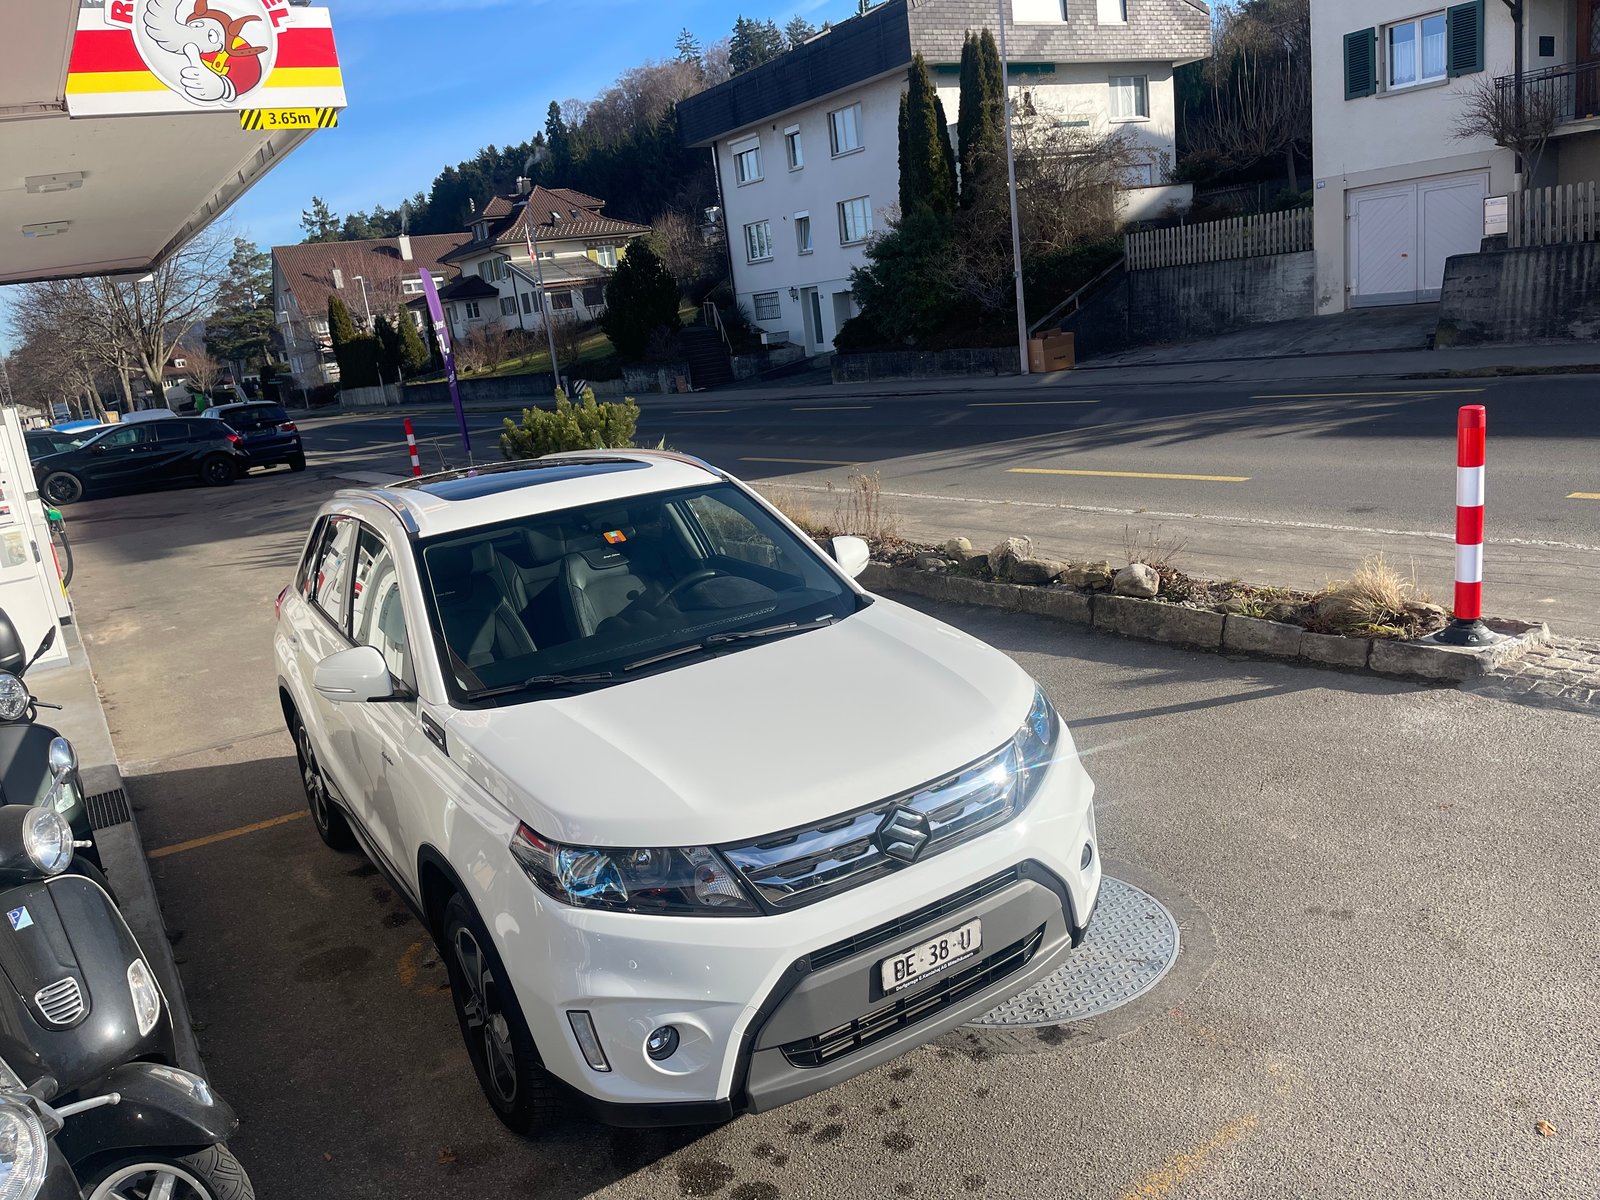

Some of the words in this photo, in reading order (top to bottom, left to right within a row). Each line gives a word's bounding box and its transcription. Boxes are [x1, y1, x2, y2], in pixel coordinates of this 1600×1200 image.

[111, 0, 133, 23] R
[268, 112, 311, 124] 3.65m
[9, 911, 20, 924] P
[894, 953, 916, 982] BE
[929, 939, 949, 966] 38
[960, 928, 971, 950] U
